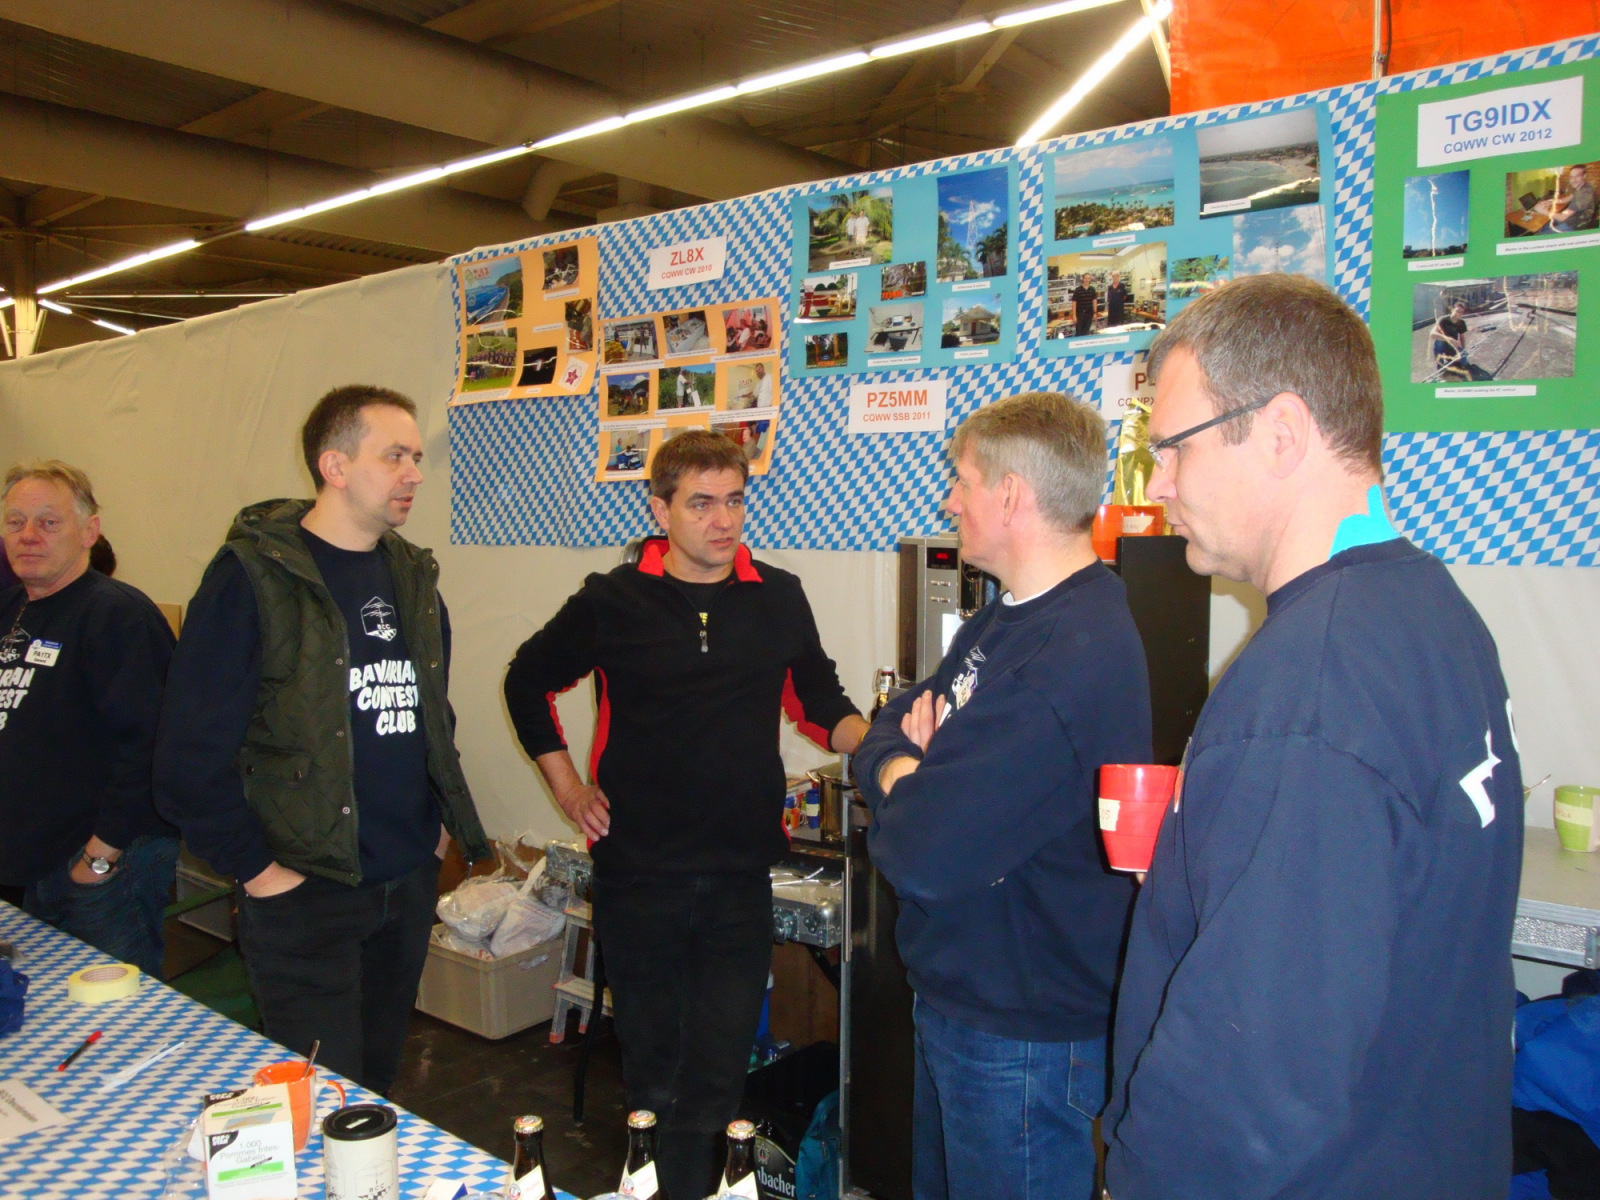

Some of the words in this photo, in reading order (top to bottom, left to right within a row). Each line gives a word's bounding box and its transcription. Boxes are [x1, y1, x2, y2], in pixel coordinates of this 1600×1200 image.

[1445, 98, 1552, 136] TG9IDX
[1443, 137, 1488, 154] CQWW
[1492, 132, 1515, 145] CW
[1519, 128, 1552, 142] 2012
[670, 246, 704, 266] ZL8X
[661, 269, 683, 279] CQWW
[685, 267, 696, 276] CW
[697, 264, 712, 274] 2010
[867, 389, 927, 409] PZ5MM
[863, 413, 891, 422] CQWW
[893, 412, 910, 421] SSB
[912, 411, 930, 420] 2011
[357, 685, 419, 711] CONTEST
[376, 710, 416, 736] CLUB
[220, 1148, 256, 1160] Pommes
